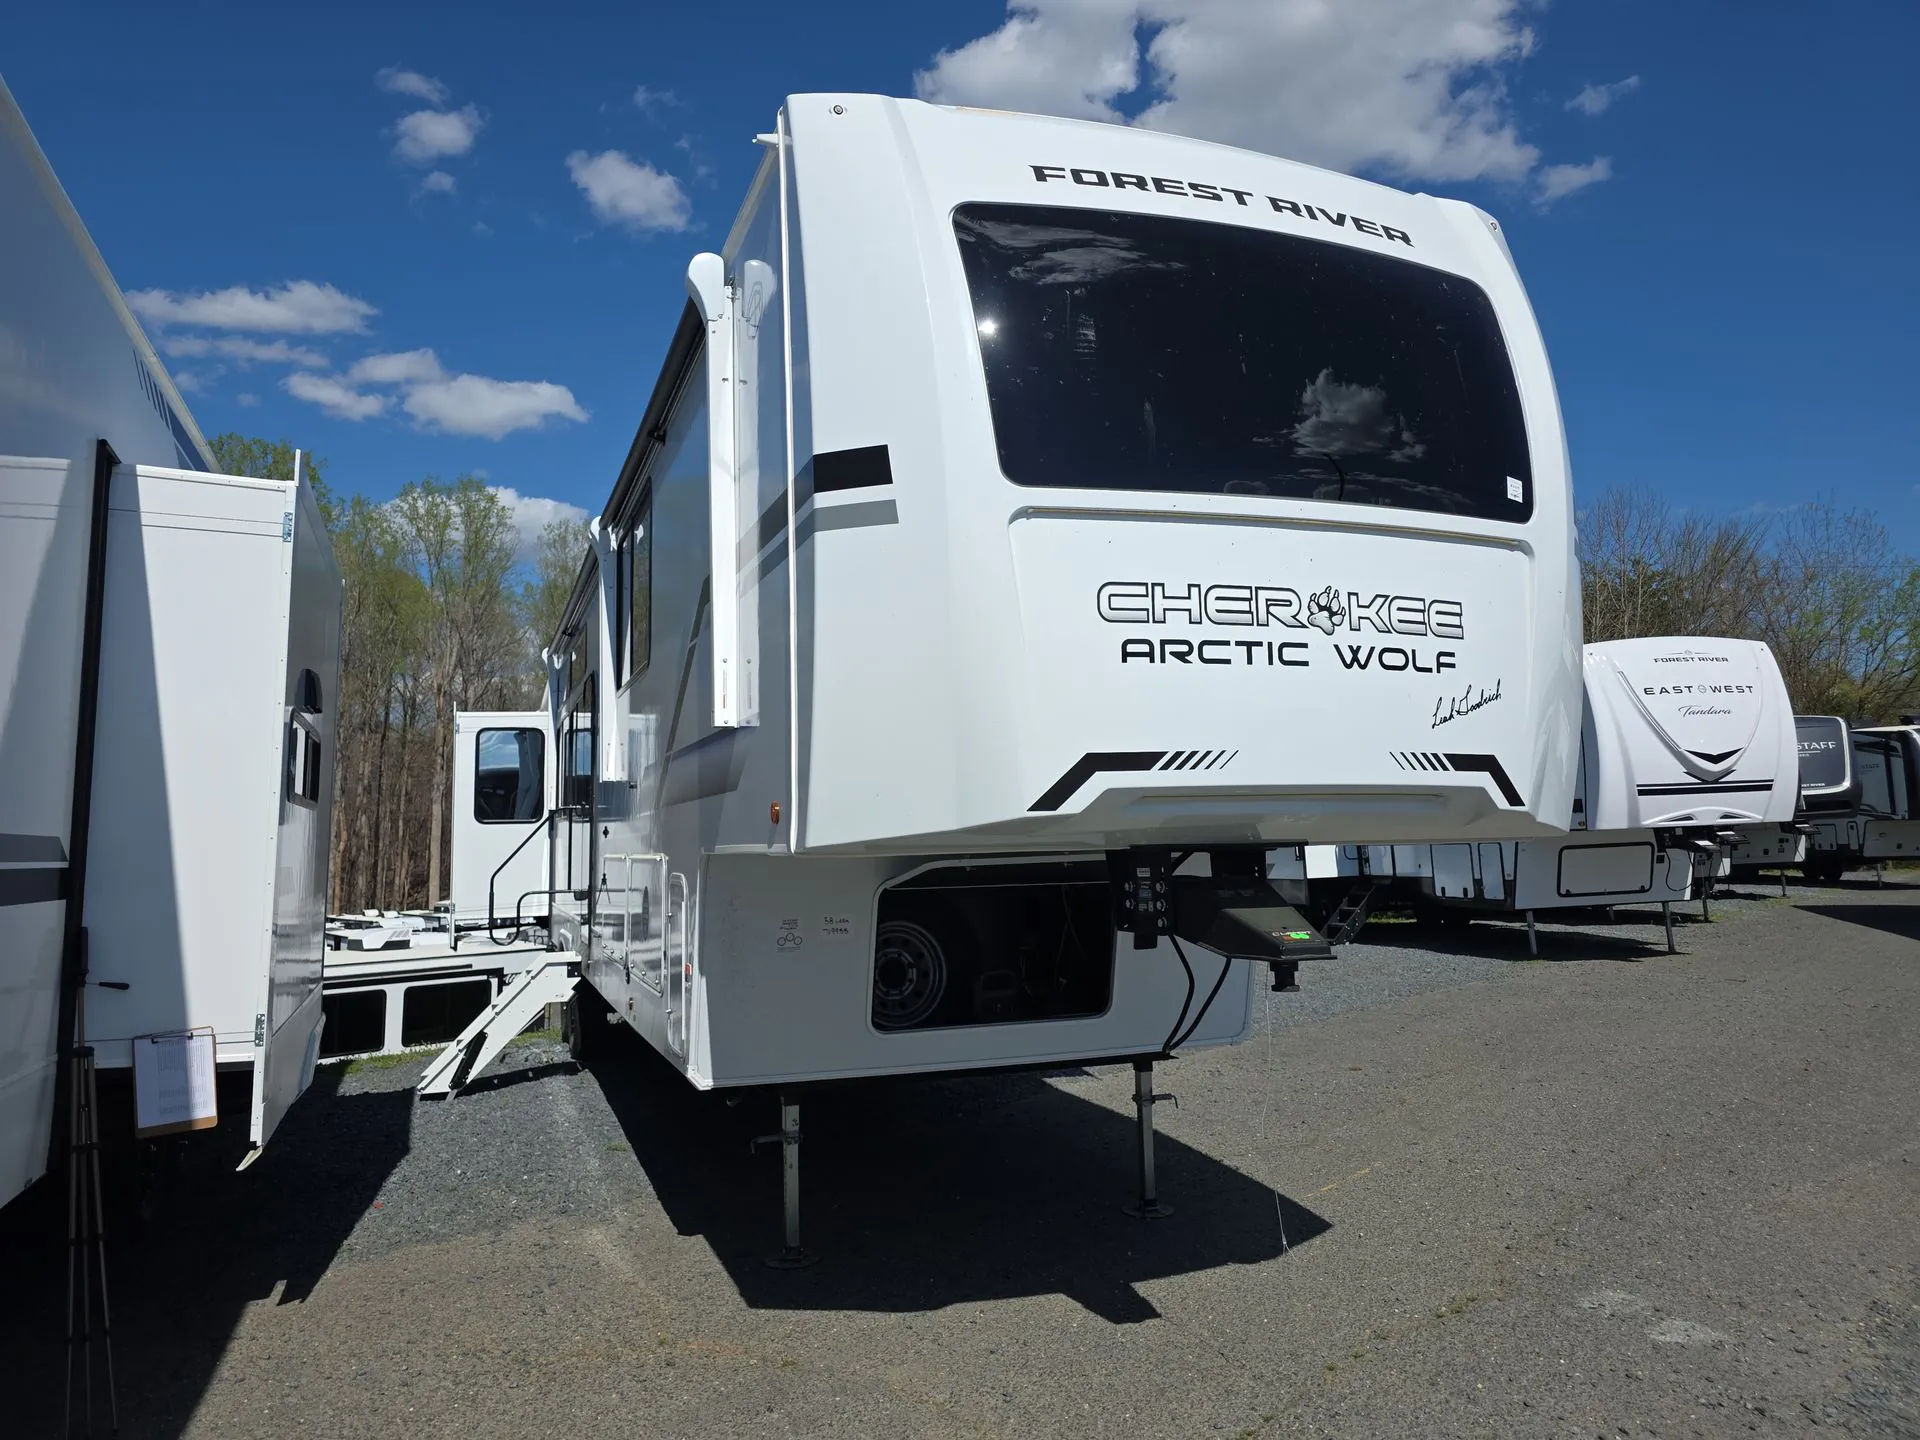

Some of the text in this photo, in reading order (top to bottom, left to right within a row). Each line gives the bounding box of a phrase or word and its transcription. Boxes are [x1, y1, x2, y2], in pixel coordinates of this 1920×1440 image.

[1029, 165, 1415, 248] FOREST RIVER
[1121, 638, 1457, 674] ARCTIC WOLF
[1643, 685, 1754, 695] EAST WEST
[1678, 705, 1732, 718] Tandara
